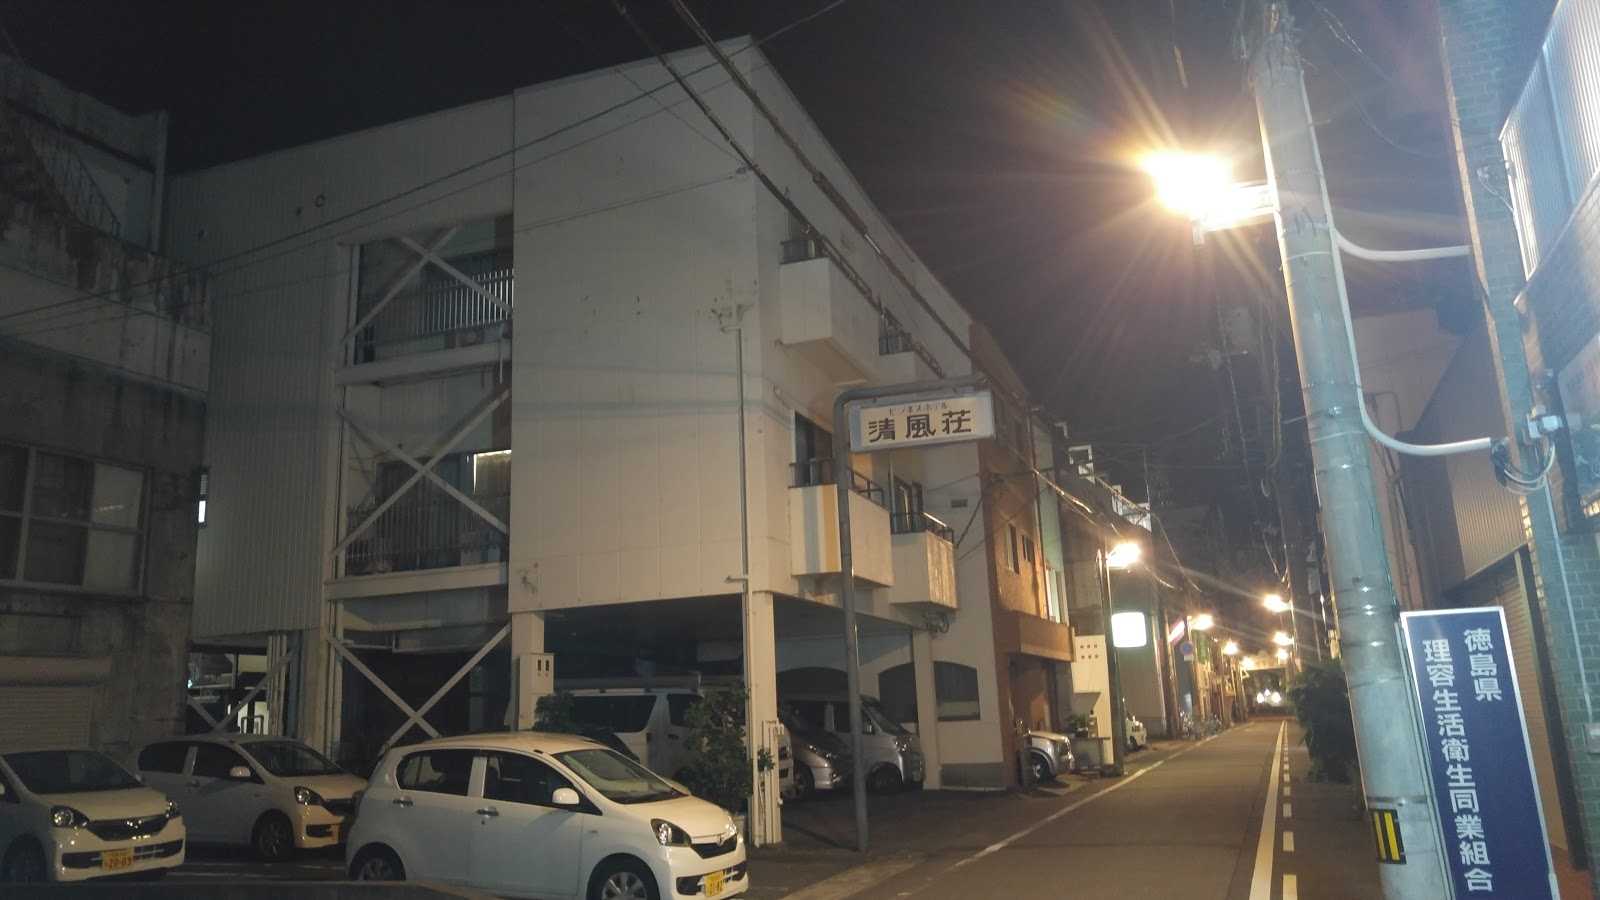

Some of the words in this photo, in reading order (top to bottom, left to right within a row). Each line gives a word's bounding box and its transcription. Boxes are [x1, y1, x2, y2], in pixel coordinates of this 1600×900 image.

[868, 410, 972, 443] 清風荘
[1463, 628, 1502, 702] 徳島県
[1422, 639, 1493, 893] 理容生活衛生同業組合
